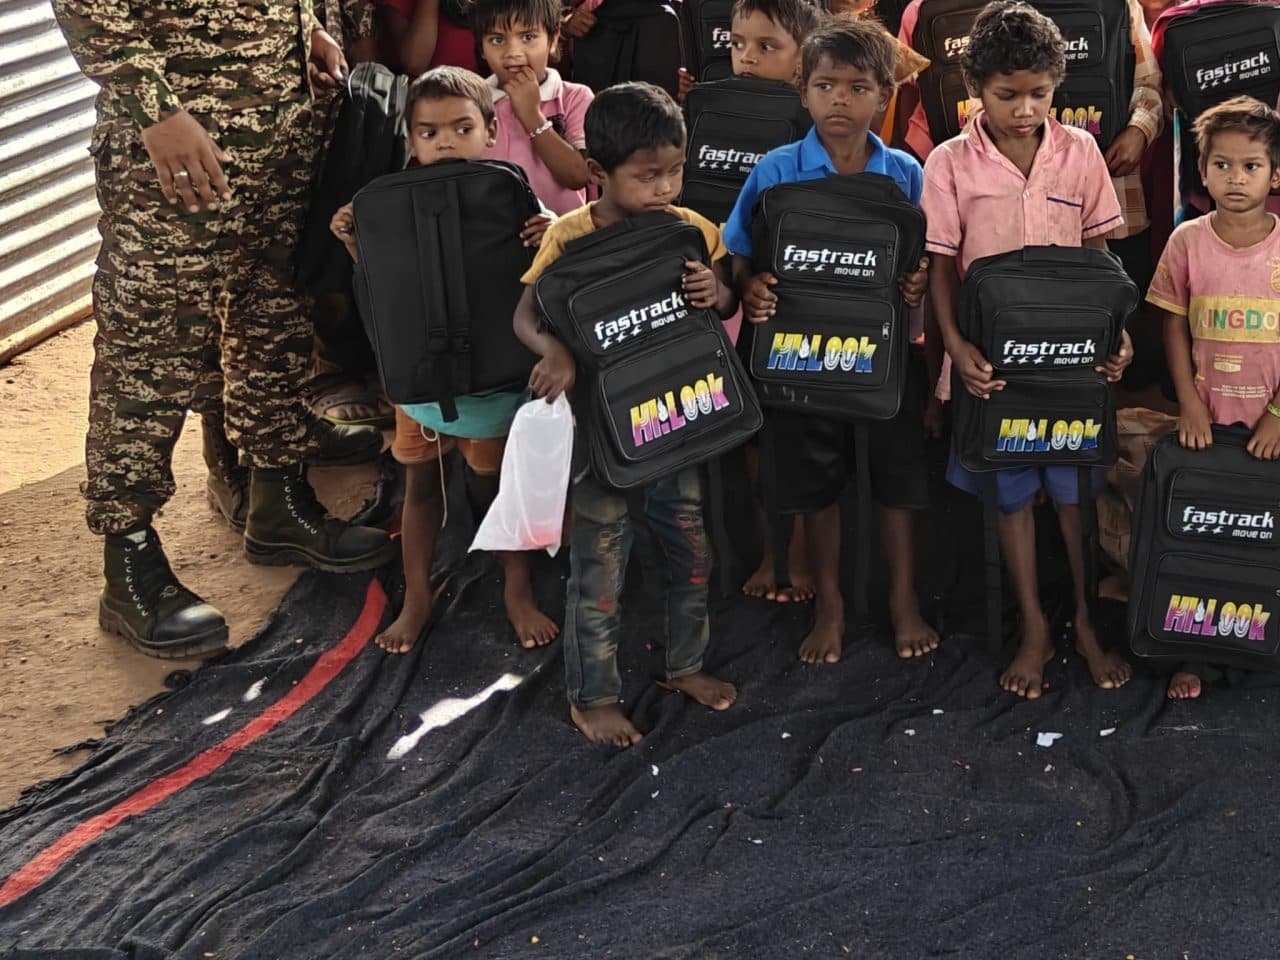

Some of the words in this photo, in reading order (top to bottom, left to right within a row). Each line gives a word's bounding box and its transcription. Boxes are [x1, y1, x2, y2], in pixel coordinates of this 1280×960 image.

[1196, 51, 1270, 82] fastrack
[698, 145, 765, 164] fastrac
[784, 244, 877, 267] fastrack
[593, 290, 684, 341] fastrack
[1003, 339, 1096, 355] fastrack
[1182, 506, 1274, 528] fastrack
